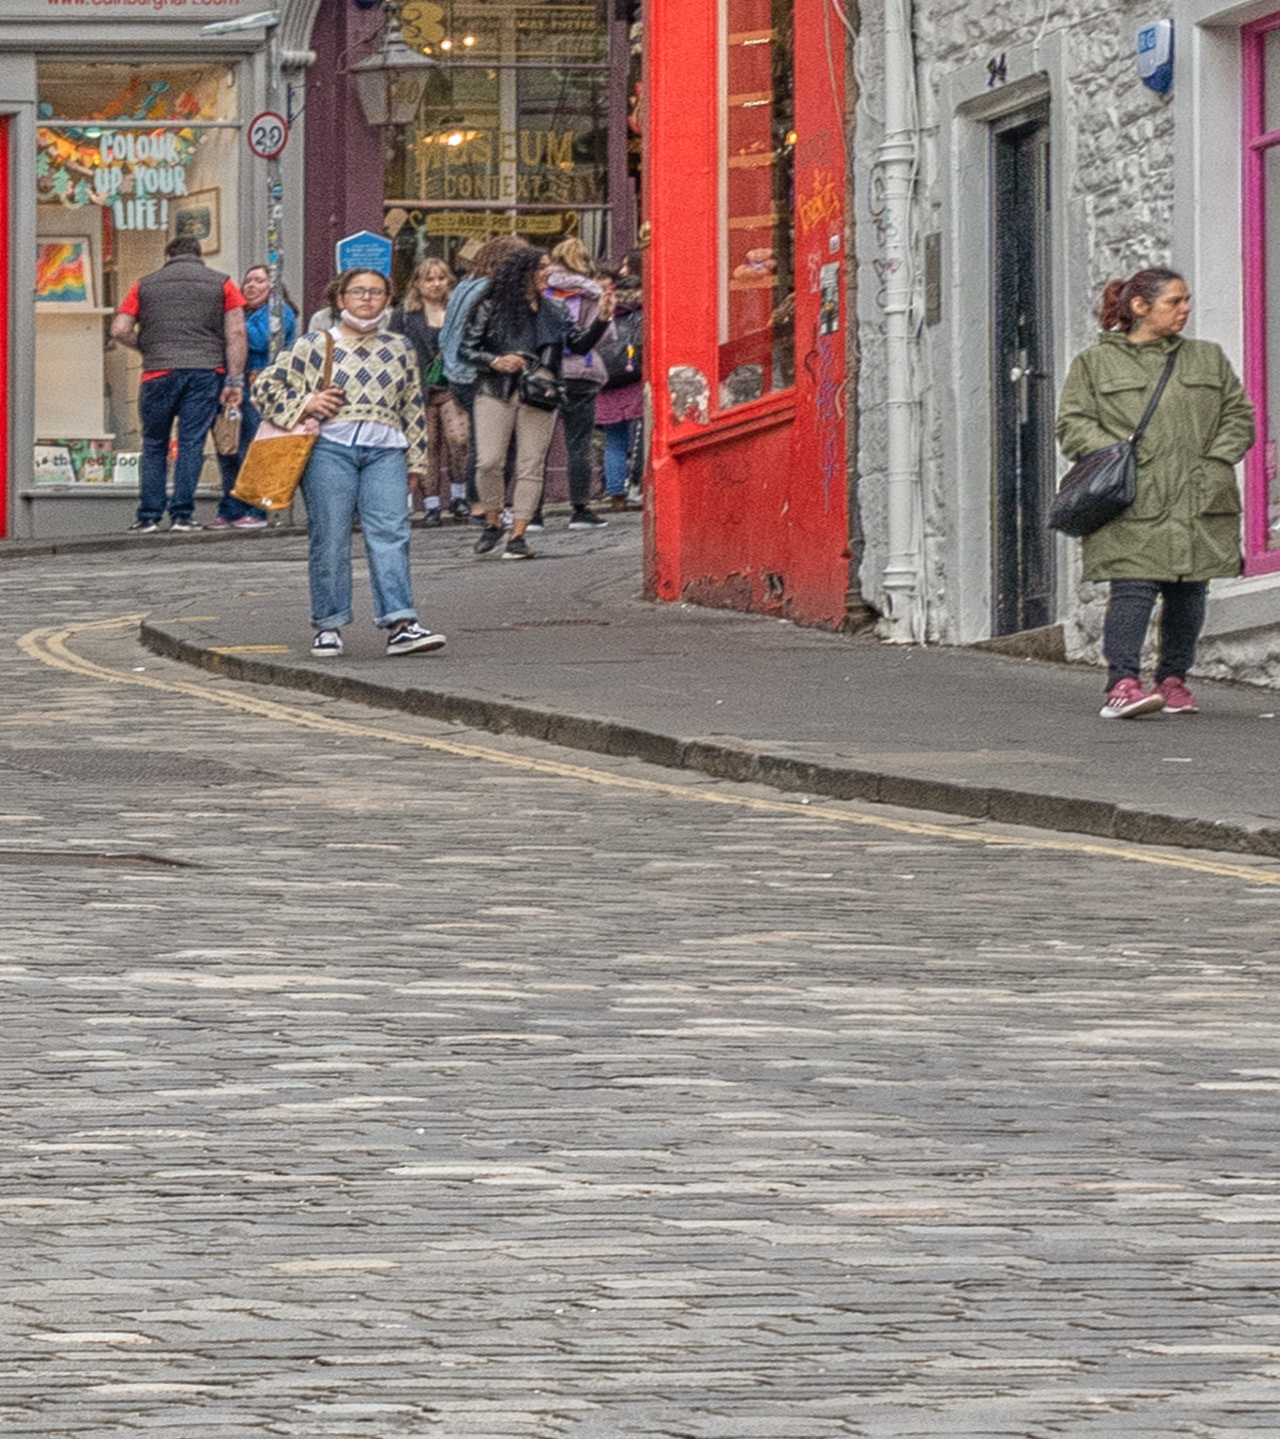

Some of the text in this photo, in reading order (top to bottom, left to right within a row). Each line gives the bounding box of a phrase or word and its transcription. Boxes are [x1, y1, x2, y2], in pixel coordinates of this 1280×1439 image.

[99, 131, 179, 163] COLOUR
[253, 126, 283, 148] 20
[94, 165, 189, 197] UP YOUR
[112, 199, 169, 231] LIFE!
